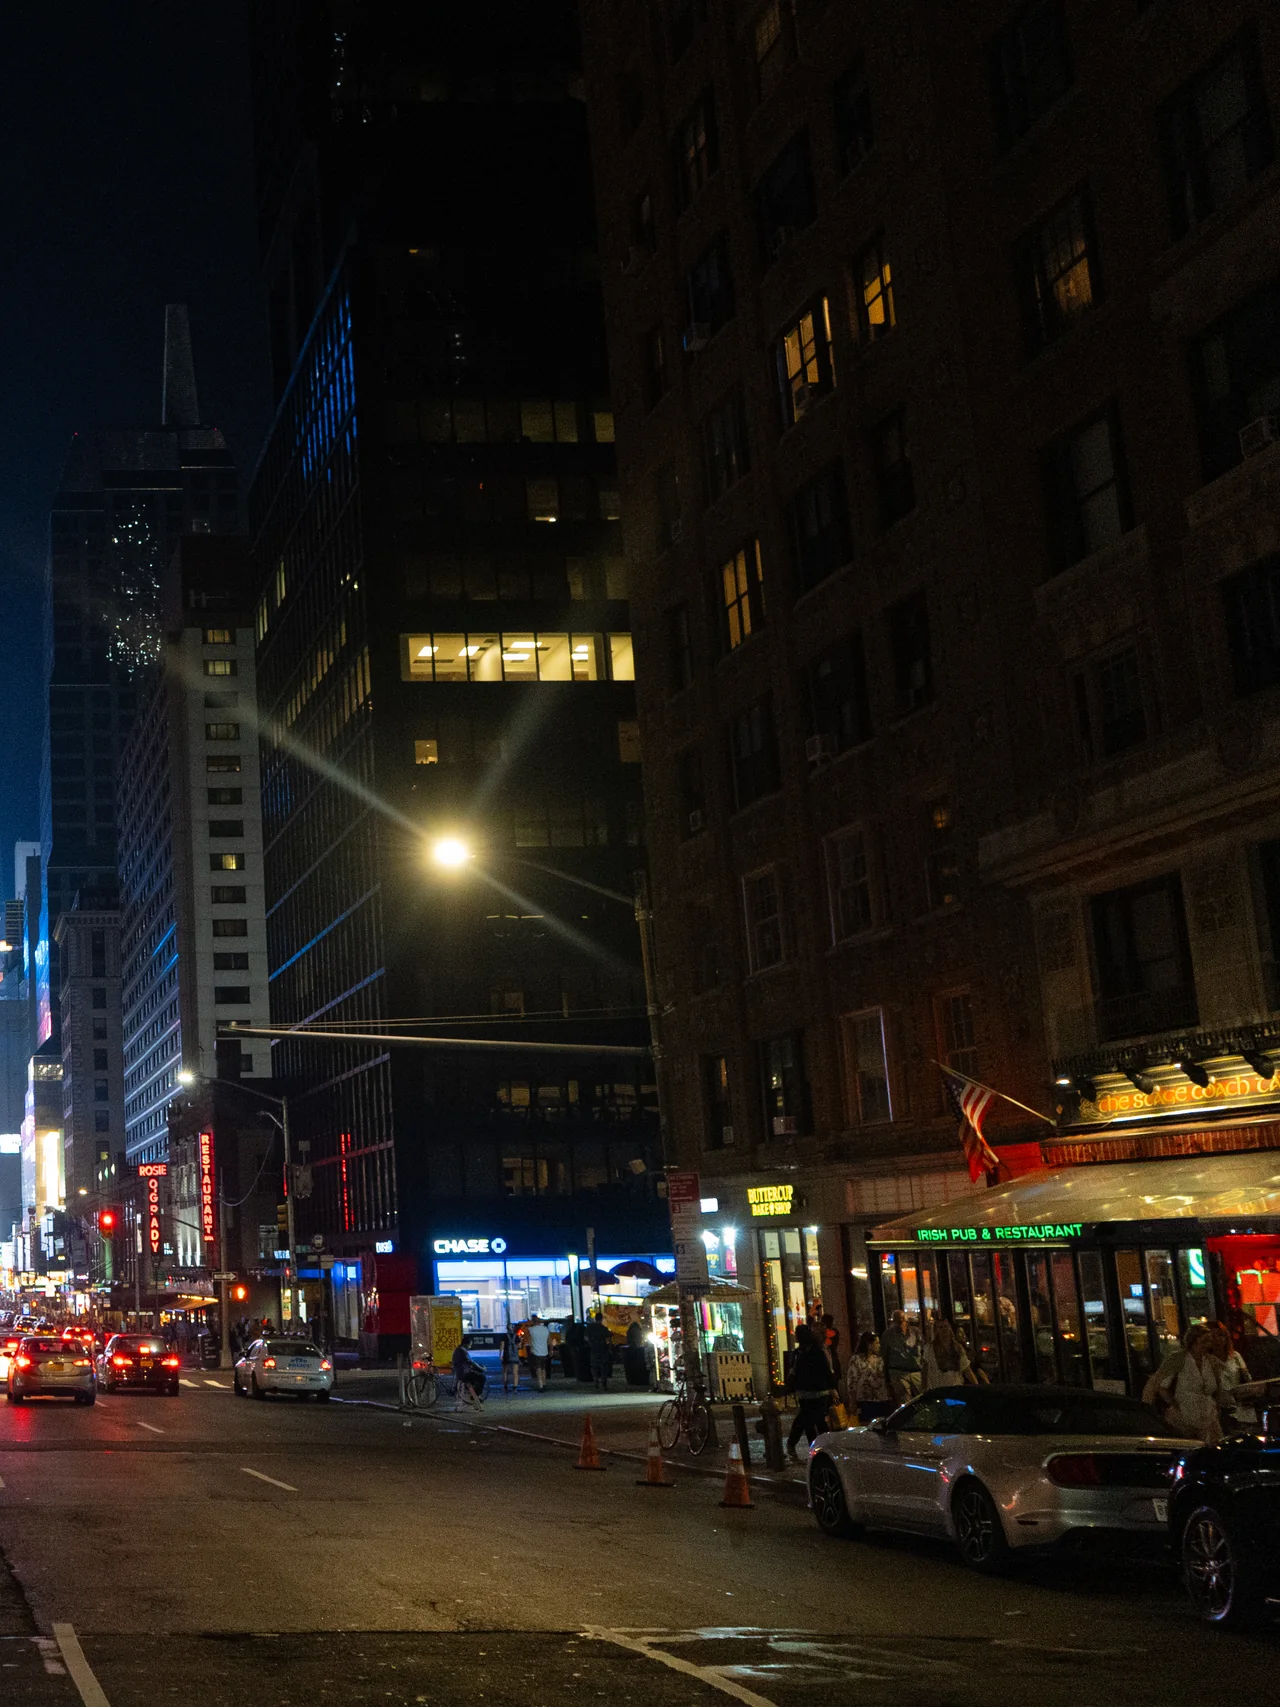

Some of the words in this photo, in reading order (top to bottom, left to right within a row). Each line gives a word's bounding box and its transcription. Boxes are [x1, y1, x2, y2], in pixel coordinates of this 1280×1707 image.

[138, 1165, 167, 1177] ROSIE
[201, 1134, 213, 1234] RESTAURANT
[747, 1184, 794, 1204] BUTTERCUP
[917, 1229, 948, 1241] IRISH
[952, 1228, 978, 1241] PUB
[981, 1227, 991, 1240] &
[995, 1223, 1083, 1239] RESTAURANT
[433, 1239, 490, 1254] CHASE
